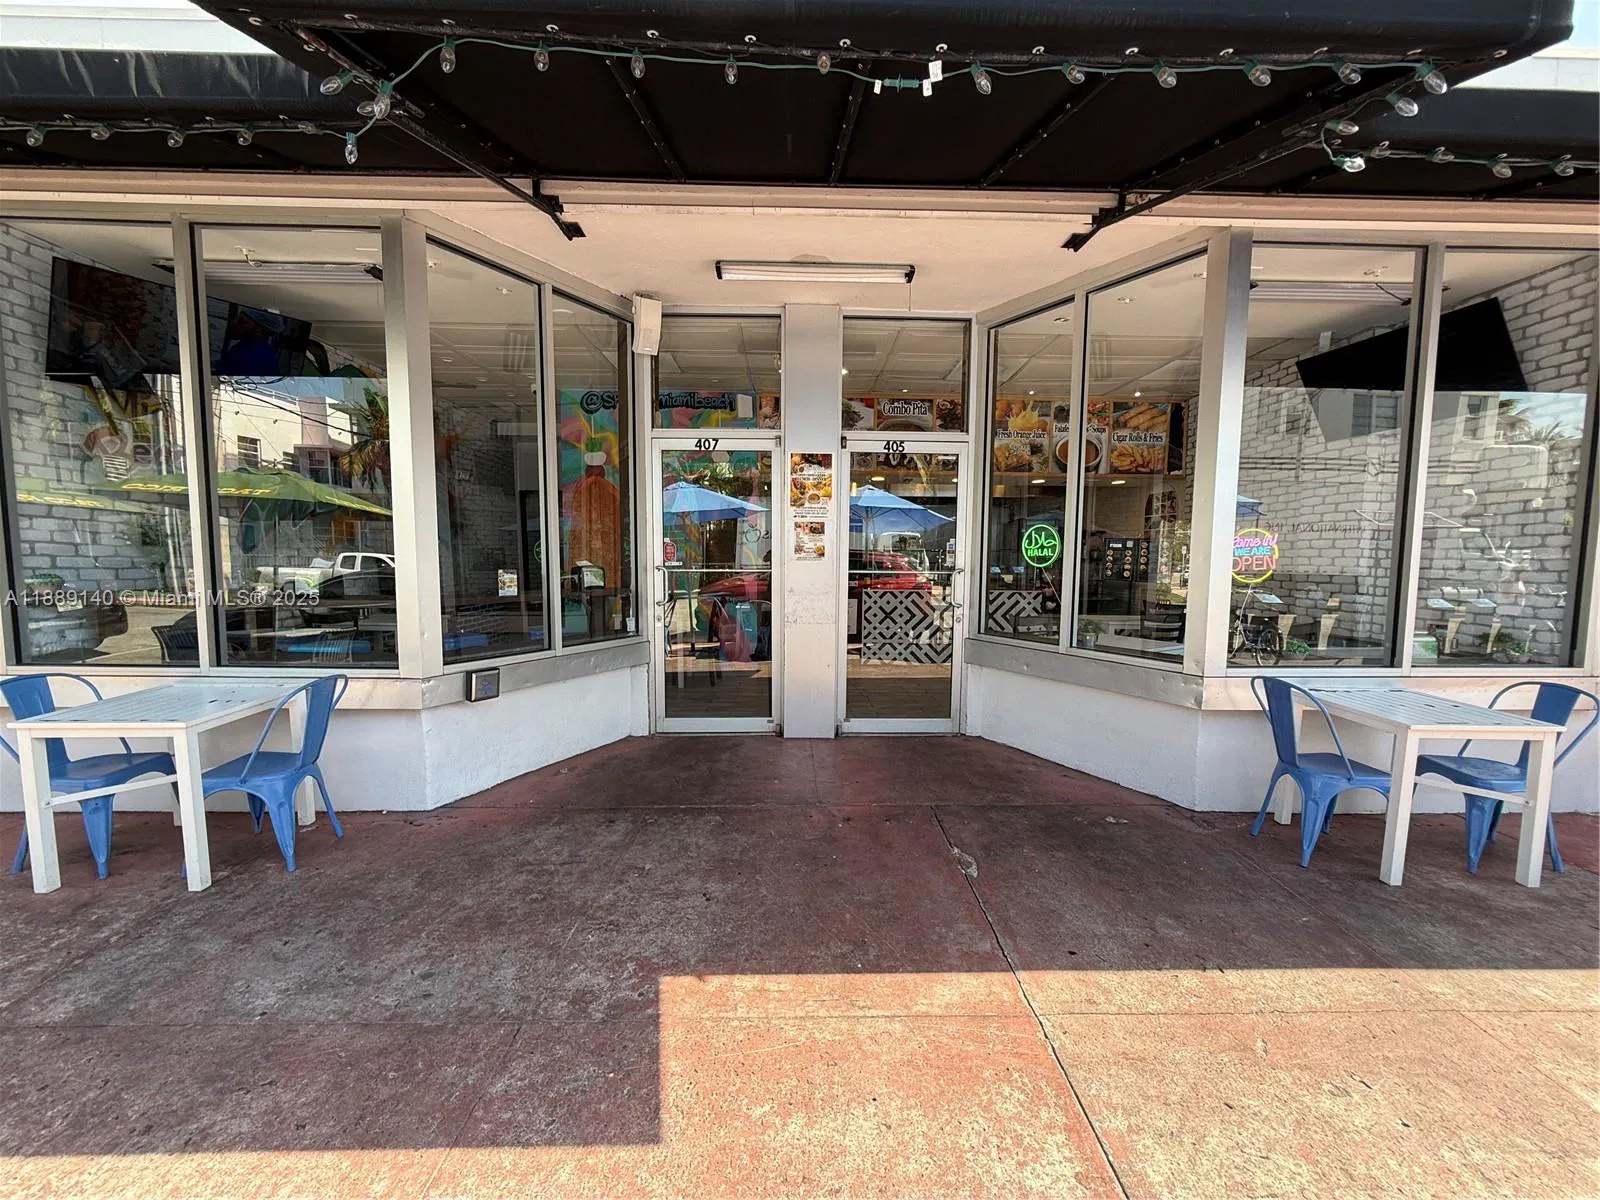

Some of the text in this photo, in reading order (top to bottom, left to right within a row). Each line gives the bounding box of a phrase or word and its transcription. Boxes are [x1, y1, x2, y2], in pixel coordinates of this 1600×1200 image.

[883, 401, 928, 415] Combo Pita
[997, 430, 1046, 440] Fresh Orange Juice
[1112, 431, 1128, 443] Cigar
[1128, 432, 1143, 442] Rolls
[1149, 432, 1164, 442] Fries
[695, 439, 718, 450] 407
[883, 441, 905, 452] 405
[1024, 530, 1057, 549] حلال
[1027, 548, 1053, 556] HALAL
[1234, 546, 1271, 556] WE ARE
[1231, 555, 1277, 572] OPEN
